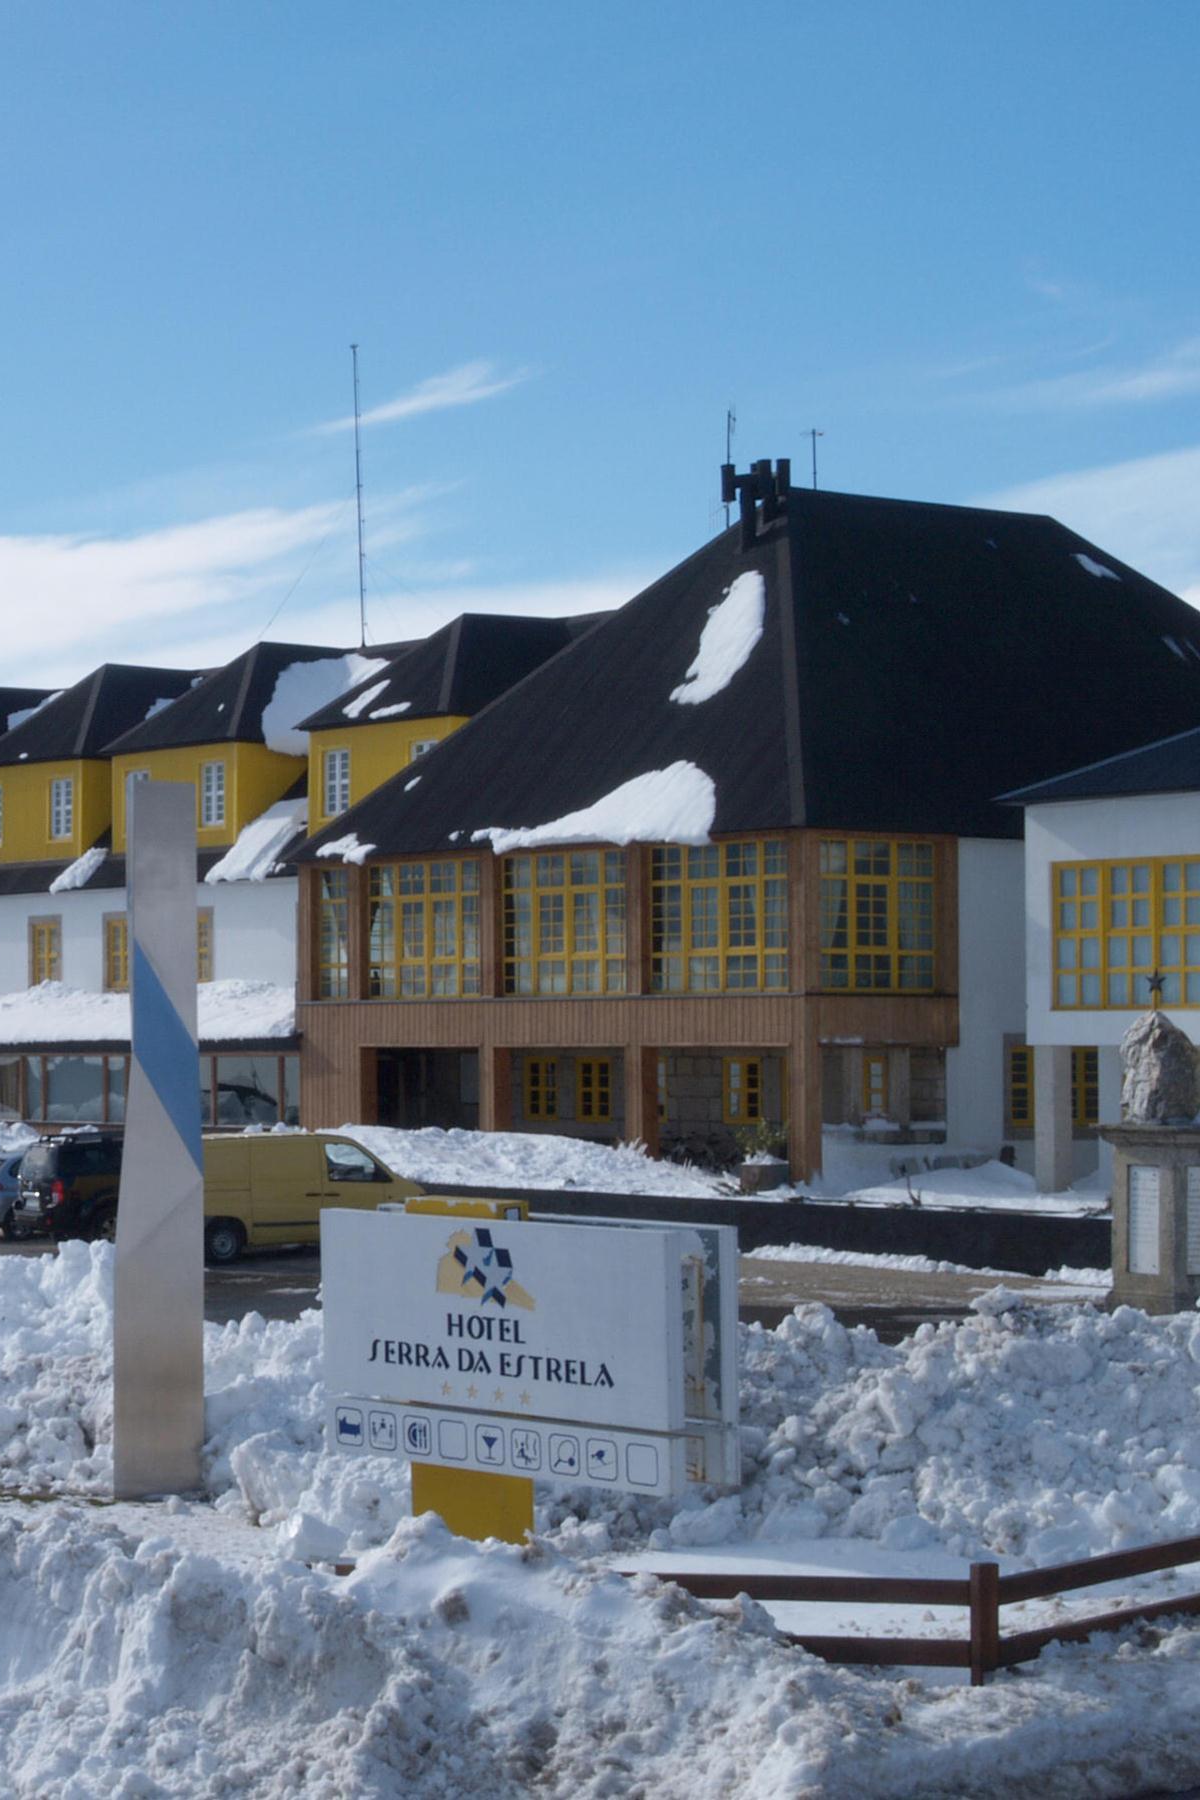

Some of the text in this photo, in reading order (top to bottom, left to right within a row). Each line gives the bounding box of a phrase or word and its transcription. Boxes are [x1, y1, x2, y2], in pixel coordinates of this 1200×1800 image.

[447, 1313, 526, 1344] HOTEL
[368, 1339, 615, 1388] SERRA DA ESTRELA
